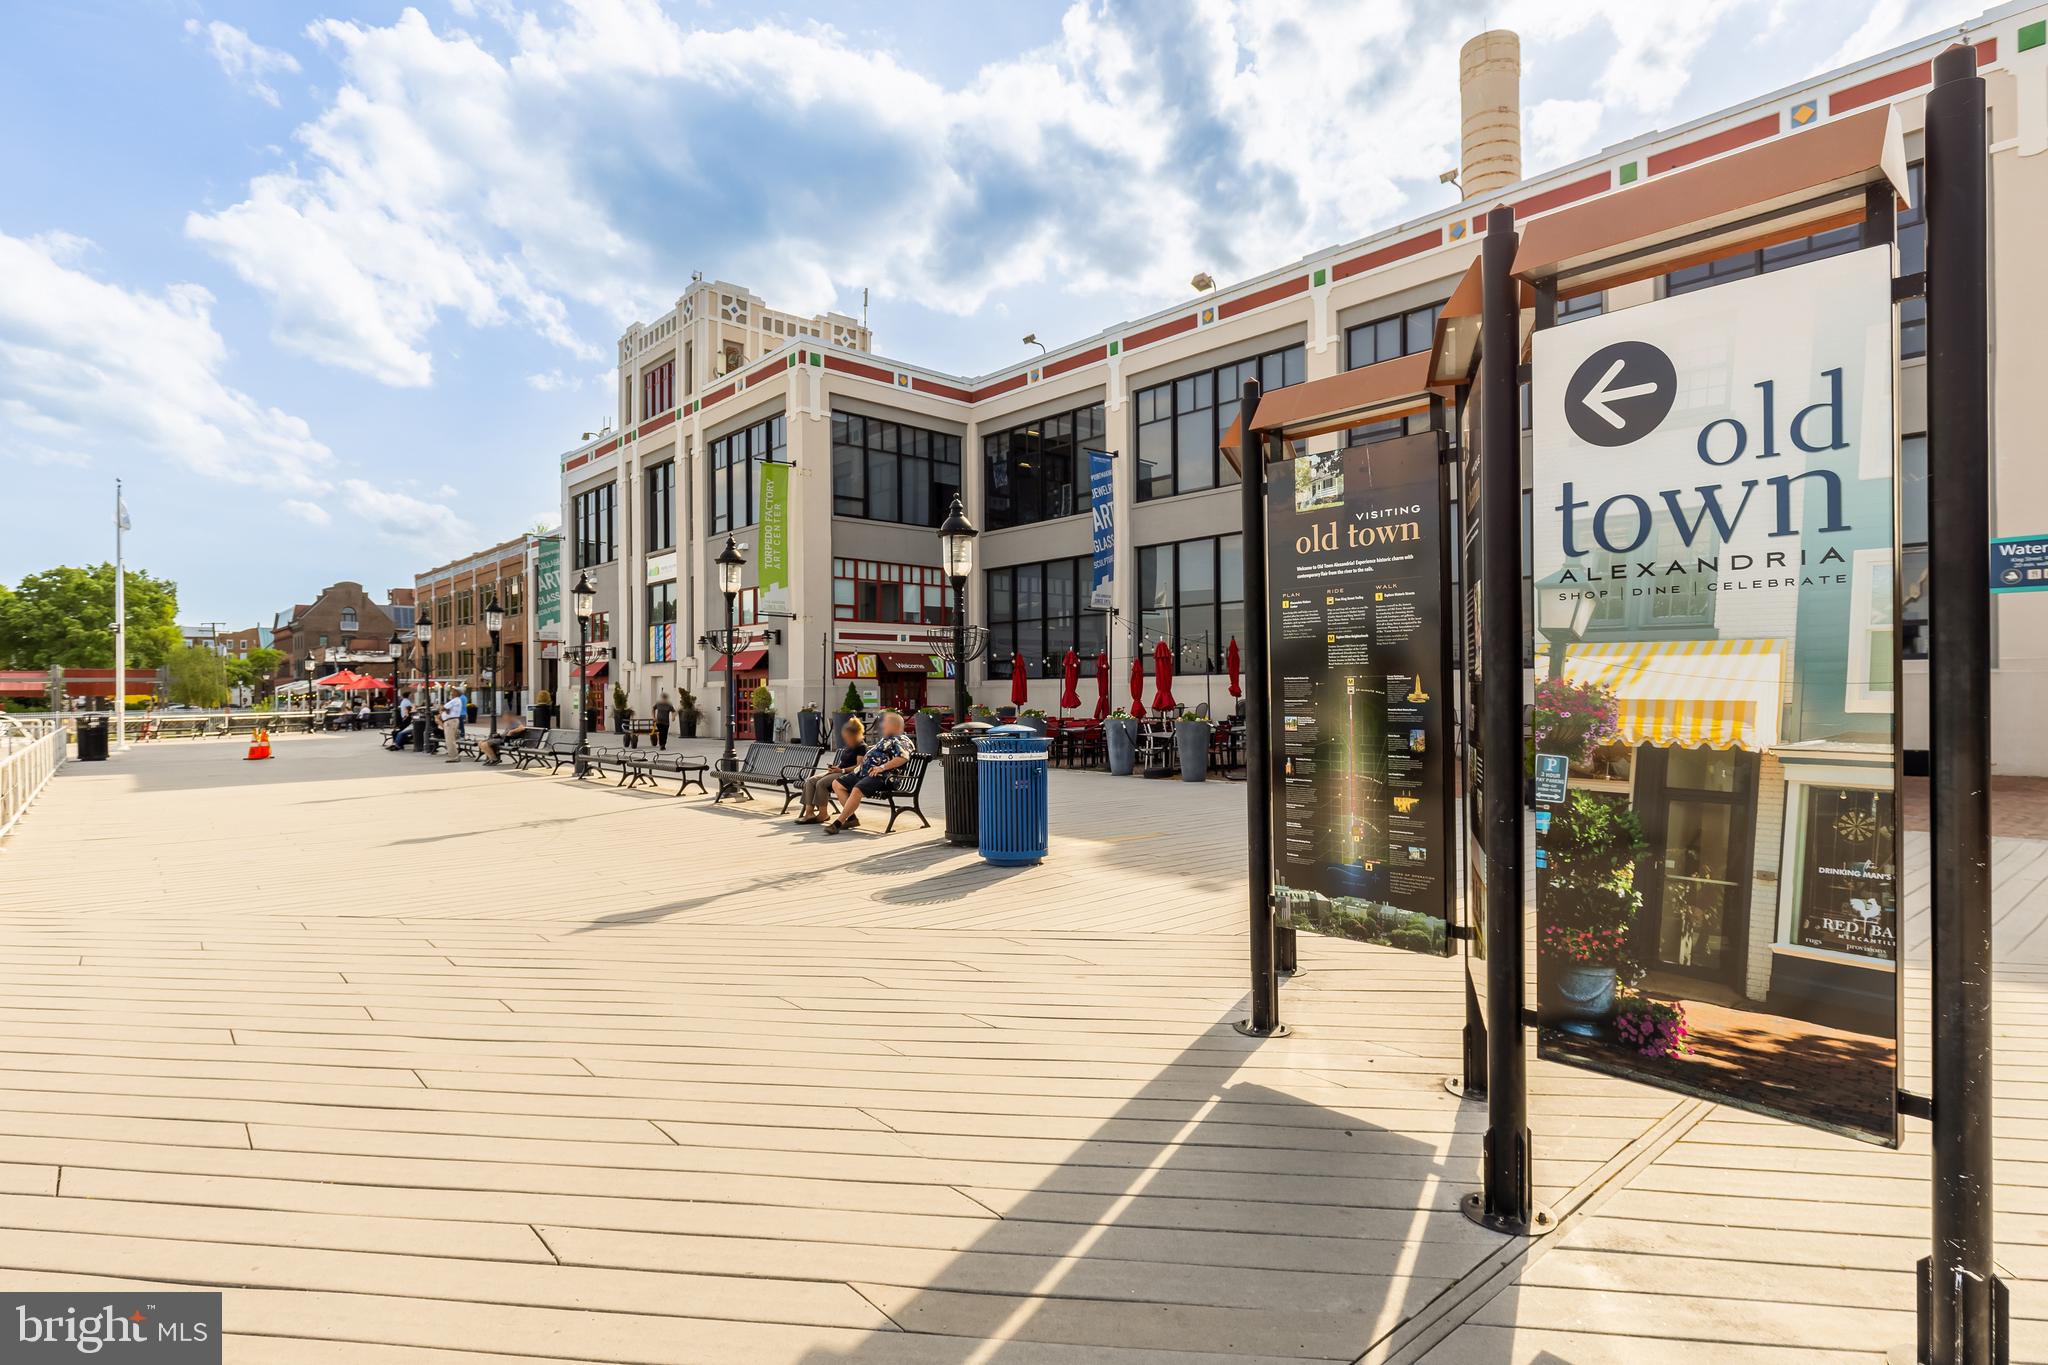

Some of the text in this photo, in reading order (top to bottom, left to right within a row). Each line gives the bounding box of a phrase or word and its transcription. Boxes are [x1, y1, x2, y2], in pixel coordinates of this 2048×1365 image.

[1697, 368, 1849, 466] old
[765, 479, 774, 568] TORPEDO FACTORY
[1093, 502, 1114, 532] ART
[1356, 505, 1421, 520] VISITING
[1555, 469, 1851, 558] town
[1094, 534, 1114, 553] GLASS
[1296, 521, 1420, 554] old town
[1999, 544, 2048, 556] Water
[1560, 546, 1846, 583] ALEXANDRIA
[539, 570, 560, 592] ART
[1559, 574, 1847, 600] SHOP DINE CELEBRATE
[538, 592, 560, 606] GLASS
[835, 654, 856, 676] ART
[857, 654, 876, 676] ART
[928, 656, 944, 675] RT
[1547, 758, 1557, 771] P
[1819, 867, 1861, 877] DRINKING
[1823, 918, 1859, 932] RED
[1847, 944, 1886, 954] provisions
